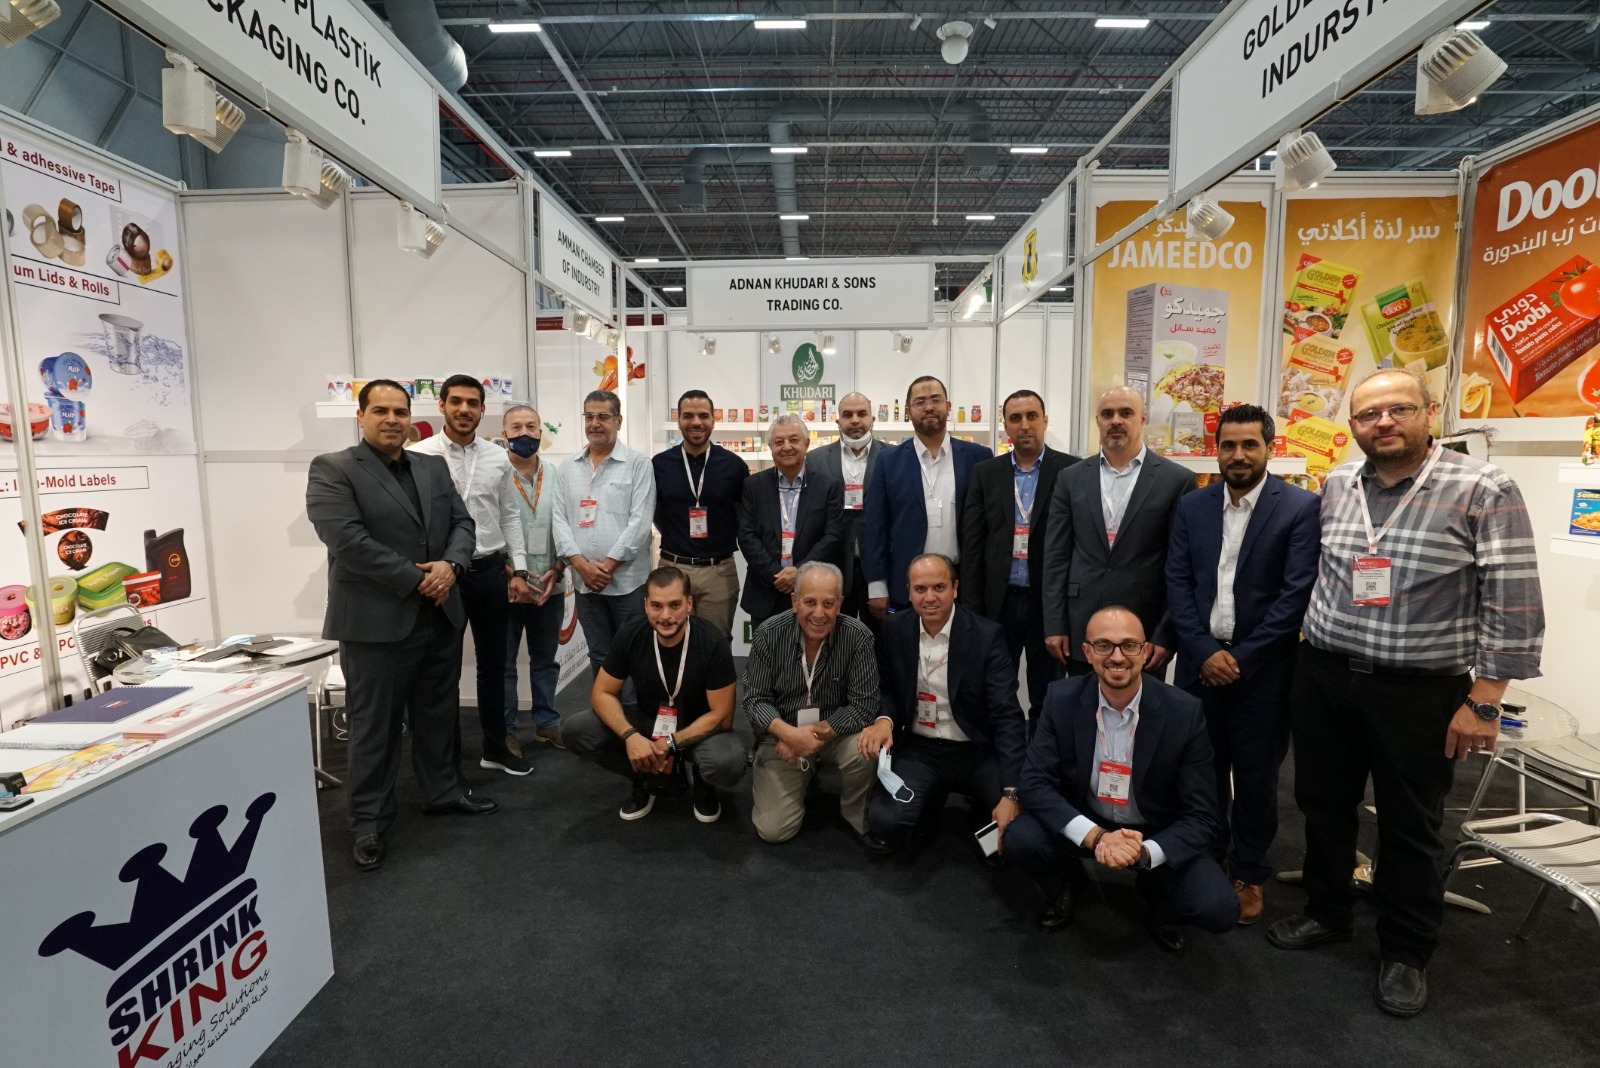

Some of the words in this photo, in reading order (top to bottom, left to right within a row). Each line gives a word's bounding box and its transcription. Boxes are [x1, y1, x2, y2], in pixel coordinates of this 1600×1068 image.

[1243, 0, 1313, 60] GOLD
[334, 78, 366, 125] CO.
[7, 142, 18, 157] &
[22, 150, 86, 183] adhessive
[88, 173, 115, 194] Tape
[1497, 160, 1600, 232] Doo
[1297, 212, 1366, 246] أكلاتي
[1373, 217, 1403, 241] لذة
[1406, 226, 1440, 243] سر
[557, 229, 580, 260] AMMAN
[580, 248, 605, 279] CHAMBER
[1108, 240, 1253, 270] JAMEEDCO
[1483, 230, 1548, 265] البندورة
[14, 265, 34, 279] um
[38, 270, 65, 286] Lids
[69, 276, 78, 289] &
[82, 280, 110, 296] Rolls
[562, 259, 570, 277] OF
[571, 270, 600, 297] INDURSTRY
[729, 277, 771, 290] ADNAN
[775, 277, 828, 290] KHUDARI
[831, 277, 840, 289] &
[843, 276, 876, 289] SONS
[1307, 269, 1341, 283] GOLDEN
[767, 298, 820, 311] TRADING
[822, 298, 843, 311] CO.
[1161, 297, 1226, 323] جميدكو
[1493, 293, 1538, 326] دوبي
[1500, 301, 1552, 341] Doobi
[1515, 340, 1535, 355] Tomato
[1534, 332, 1548, 344] paste
[1548, 321, 1563, 333] cubes
[783, 386, 833, 399] KHUDARI
[1297, 425, 1333, 440] GOLDEN
[80, 474, 117, 487] Labels
[55, 512, 88, 520] CHOCOLATE
[0, 651, 29, 669] PVC
[108, 894, 262, 1047] SHRINK
[117, 930, 268, 1068] KING
[210, 968, 271, 1032] Solutions
